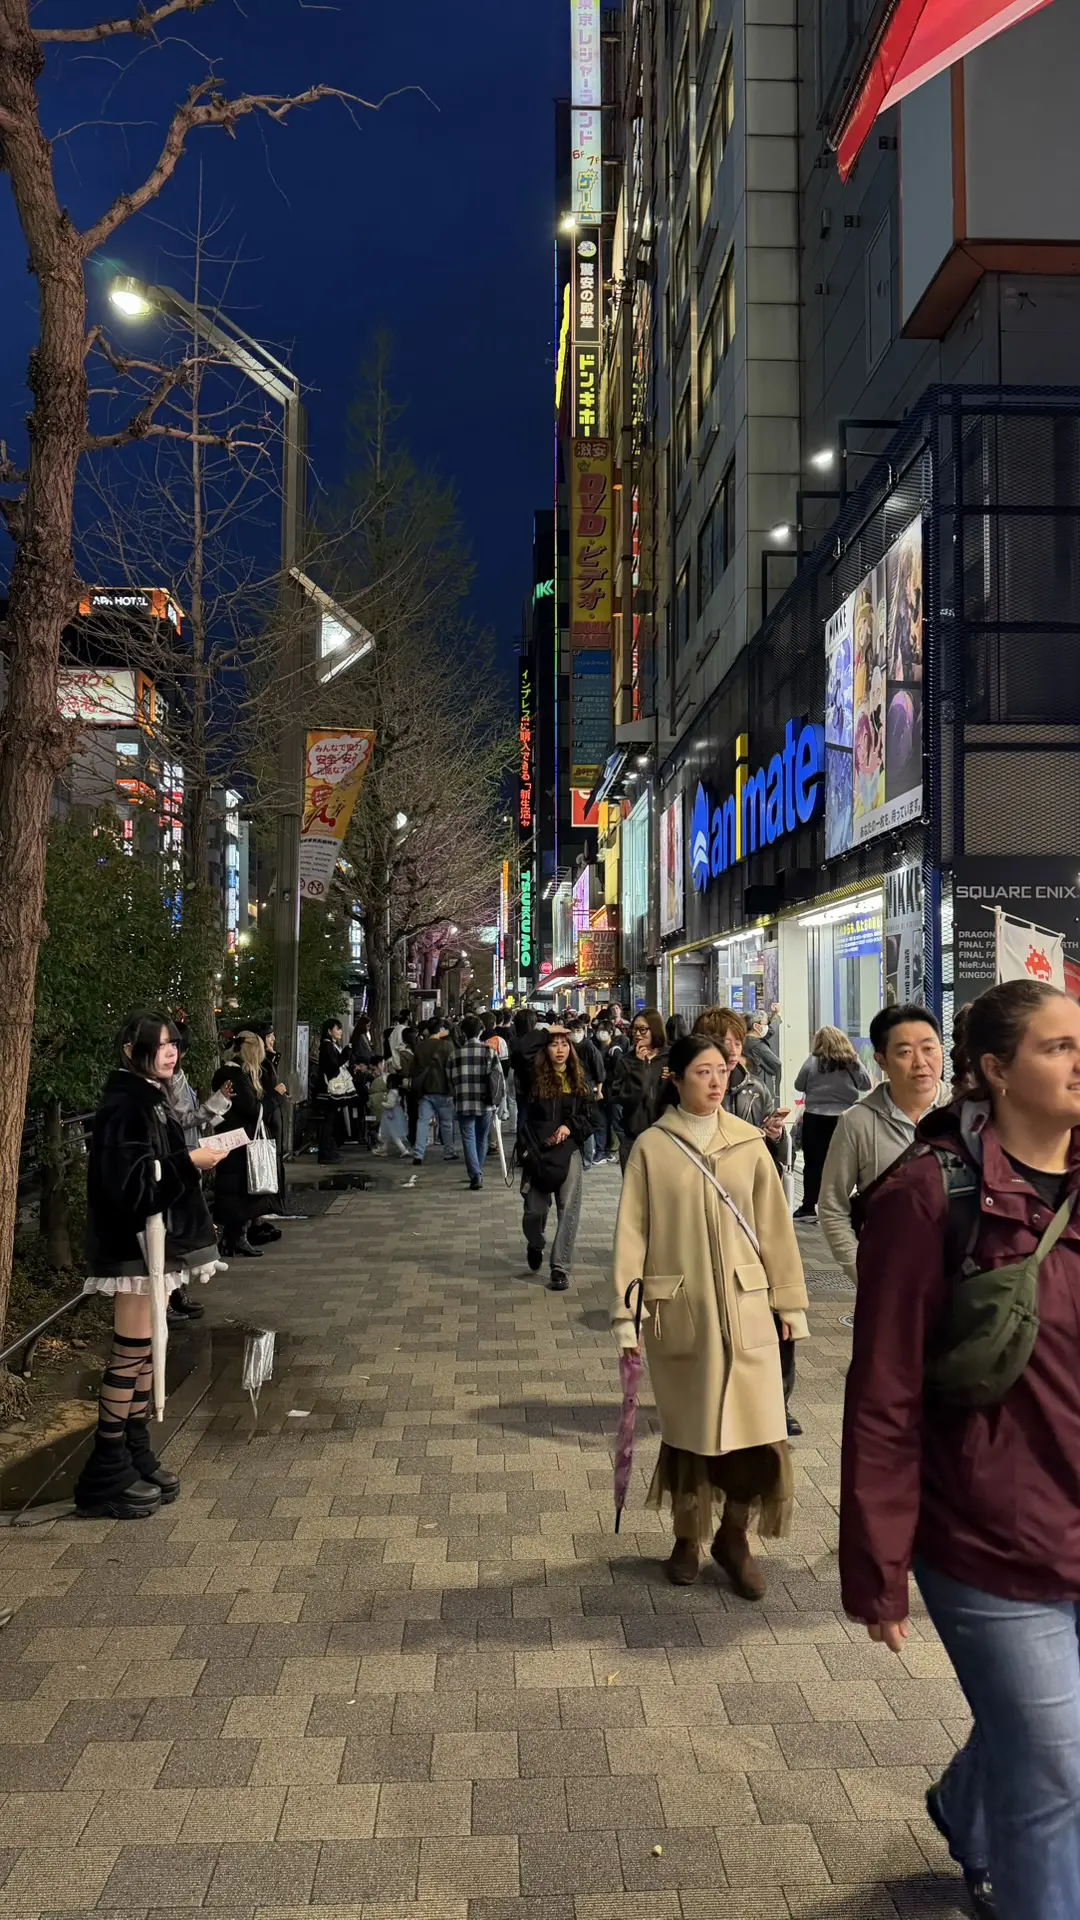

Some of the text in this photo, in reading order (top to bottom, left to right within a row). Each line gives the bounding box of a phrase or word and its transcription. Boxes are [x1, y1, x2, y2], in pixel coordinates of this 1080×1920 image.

[572, 149, 600, 166] 6F 7F
[579, 173, 594, 220] ゲーム
[579, 262, 595, 328] 驚安の殿堂
[92, 596, 149, 606] APA HOTEL
[710, 718, 824, 878] animate
[956, 885, 1075, 899] SQUARE ENIX
[520, 870, 531, 967] TSUKUMO
[958, 931, 996, 939] DRAGON
[958, 941, 984, 949] FINAL
